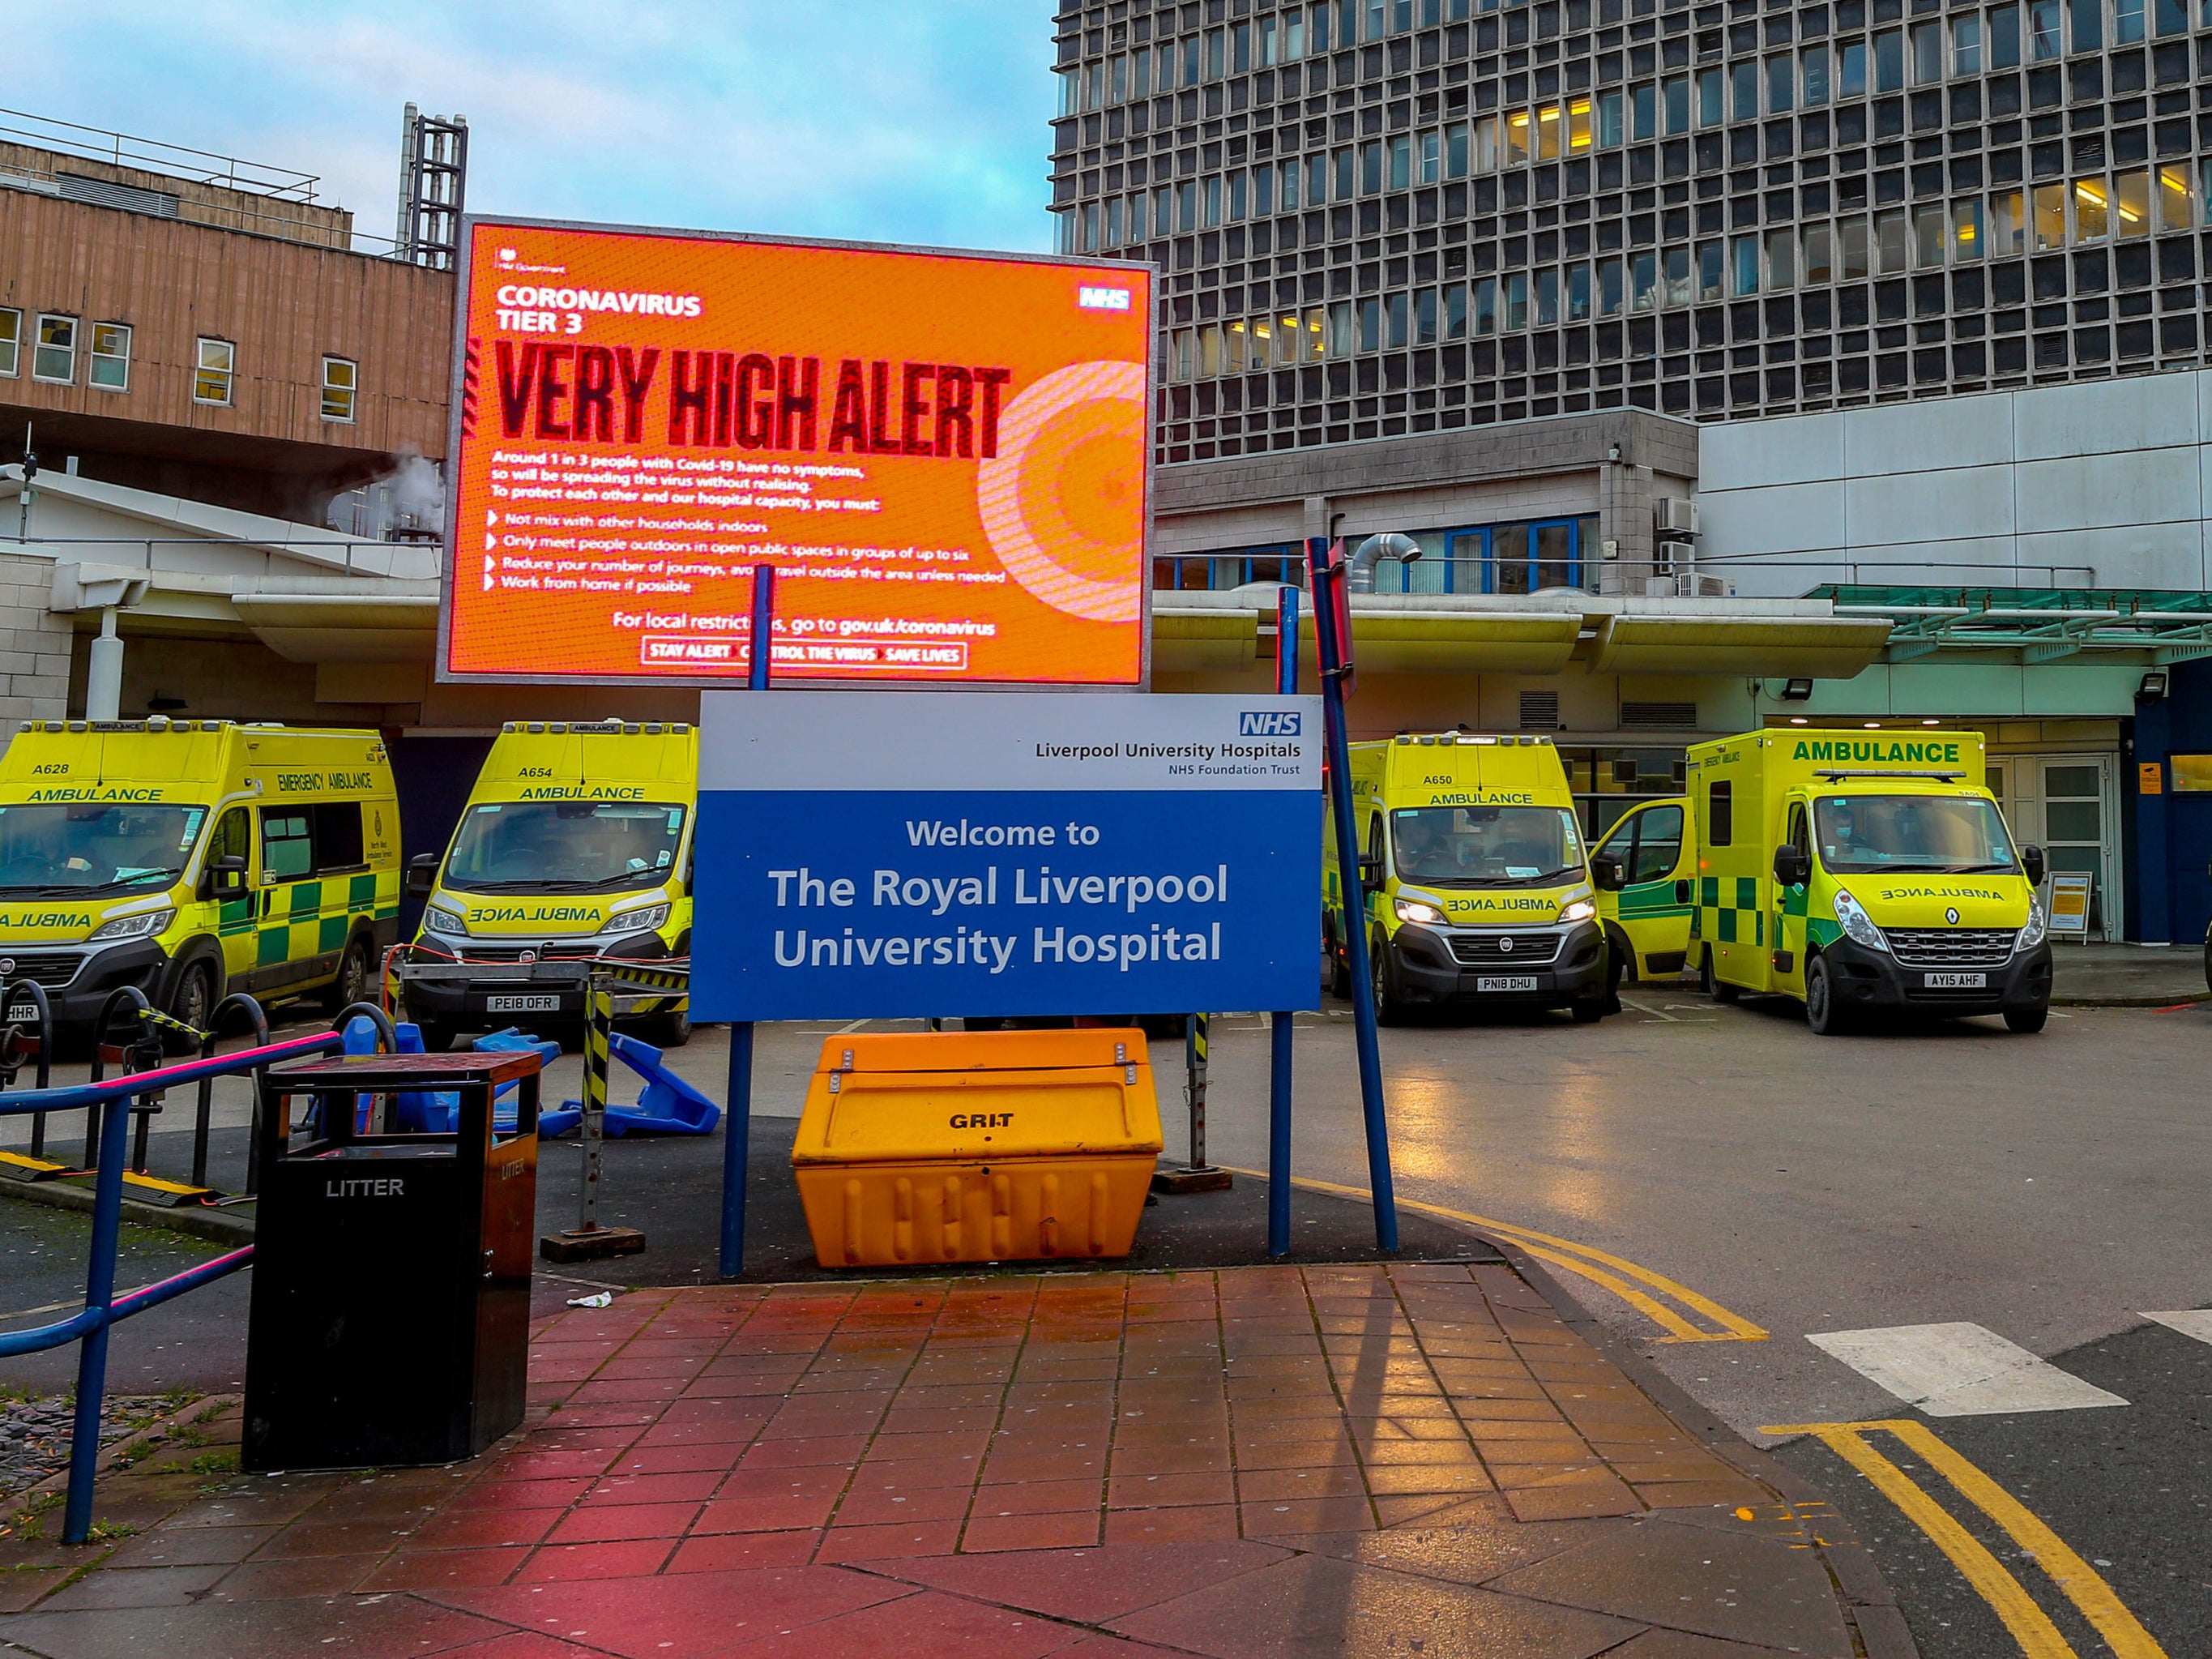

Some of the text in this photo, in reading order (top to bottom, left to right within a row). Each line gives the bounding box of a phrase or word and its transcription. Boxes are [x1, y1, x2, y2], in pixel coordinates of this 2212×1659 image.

[497, 285, 701, 317] CORONAVIRUS
[1081, 288, 1129, 310] NHS
[495, 309, 582, 334] TIER 3
[494, 340, 1011, 459] VERY HIGH ALERT
[492, 451, 865, 478] Around 1 in 3 people with Covid-19 have no symptoms,
[492, 469, 812, 494] so will be spreading the virus without realising.
[491, 485, 509, 497] To
[511, 487, 563, 499] protect
[565, 488, 598, 500] each
[600, 489, 639, 501] other
[641, 490, 668, 502] and
[671, 494, 696, 503] our
[698, 492, 752, 507] hospital
[815, 499, 840, 511] you
[505, 513, 767, 532] Not mix with other households indoors
[502, 535, 969, 562] Only meet people outdoors in open public spaces in groups of up to six
[502, 557, 1006, 583] Reduce your number of journeys, avo ravel outside the area unless needed
[501, 575, 691, 593] Work from home if possible
[613, 611, 996, 636] For local restricts, go to gov.uk/coronavirus
[650, 643, 959, 662] STAY ALERT CTROL THE VIRUS SAVE LIVES
[1241, 713, 1300, 734] NHS
[1036, 742, 1301, 761] Liverpool University Hospitals
[1793, 742, 1959, 763] AMBULANCE
[32, 763, 69, 775] A628
[518, 767, 553, 777] A654
[1169, 764, 1300, 775] NHS Foundation Trust
[277, 772, 373, 792] EMERGENCY AMBULANCE
[1423, 775, 1452, 785] A650
[26, 789, 164, 802] AMBULANCE
[519, 786, 645, 799] AMBULANCE
[1430, 793, 1533, 805] AMBULANCE
[907, 819, 1100, 847] Welcome to
[768, 864, 1228, 915] The Royal Liverpool
[774, 922, 1221, 973] University Hospital
[1484, 978, 1531, 990] PN18 DHU
[1932, 975, 1979, 986] AY15 AHF
[495, 997, 552, 1010] PE18 OFR
[950, 1113, 1014, 1129] GRIT
[502, 1157, 524, 1180] LITTER
[327, 1179, 404, 1197] LITTER
